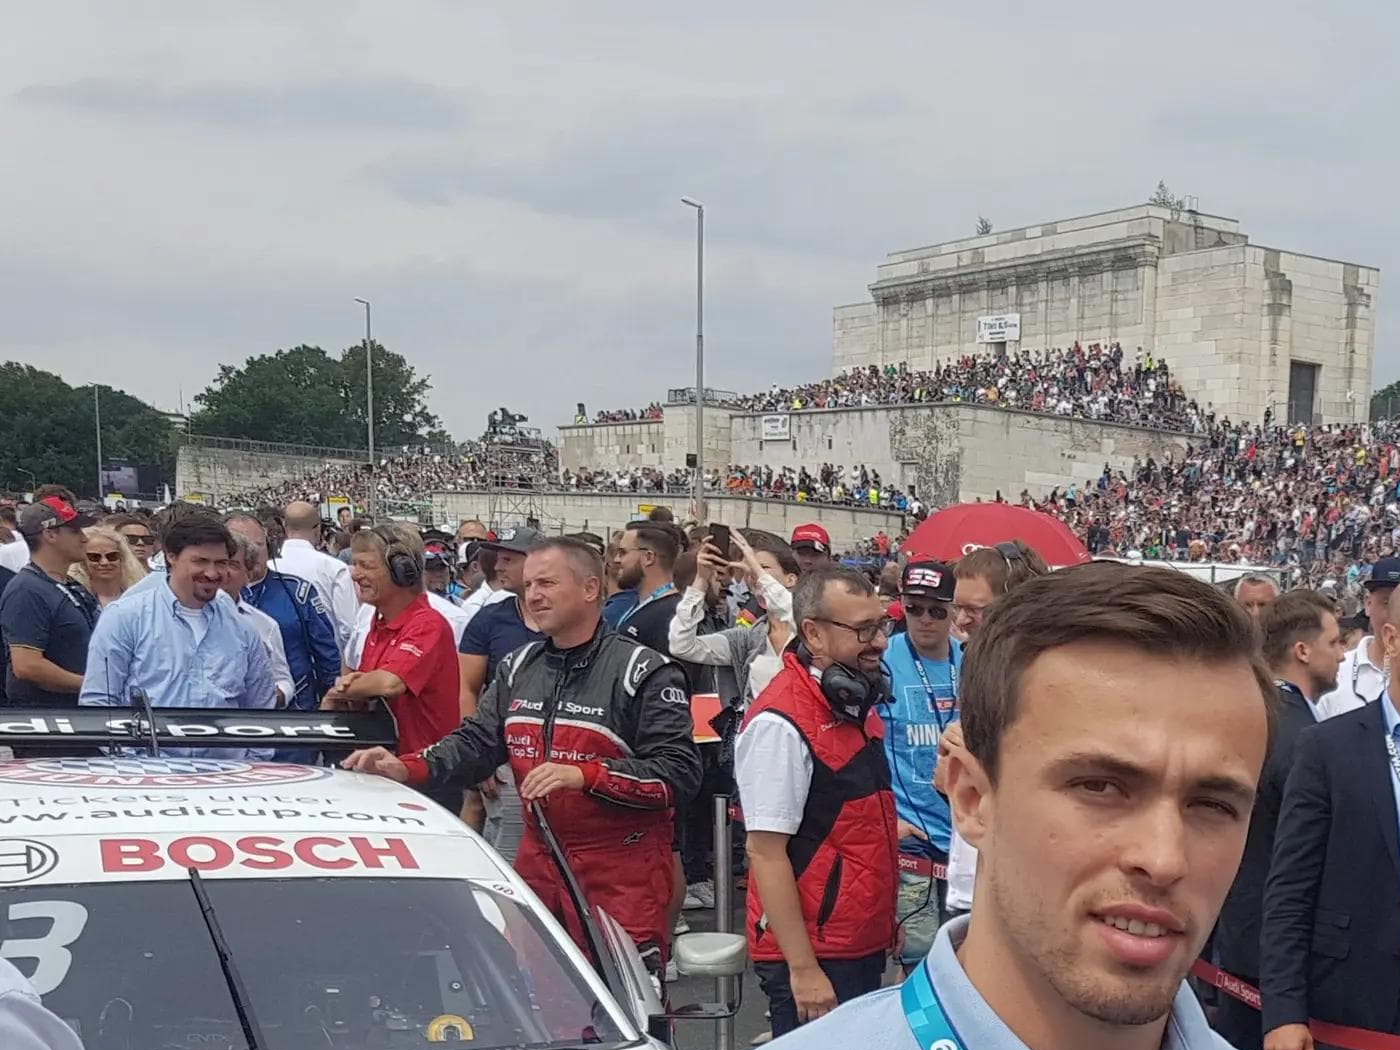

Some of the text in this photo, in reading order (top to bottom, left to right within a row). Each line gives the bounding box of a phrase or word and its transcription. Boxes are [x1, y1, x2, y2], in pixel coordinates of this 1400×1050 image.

[520, 699, 605, 716] Audi Sport
[906, 722, 940, 747] NIN
[99, 836, 420, 871] BOSCH
[898, 854, 918, 870] port
